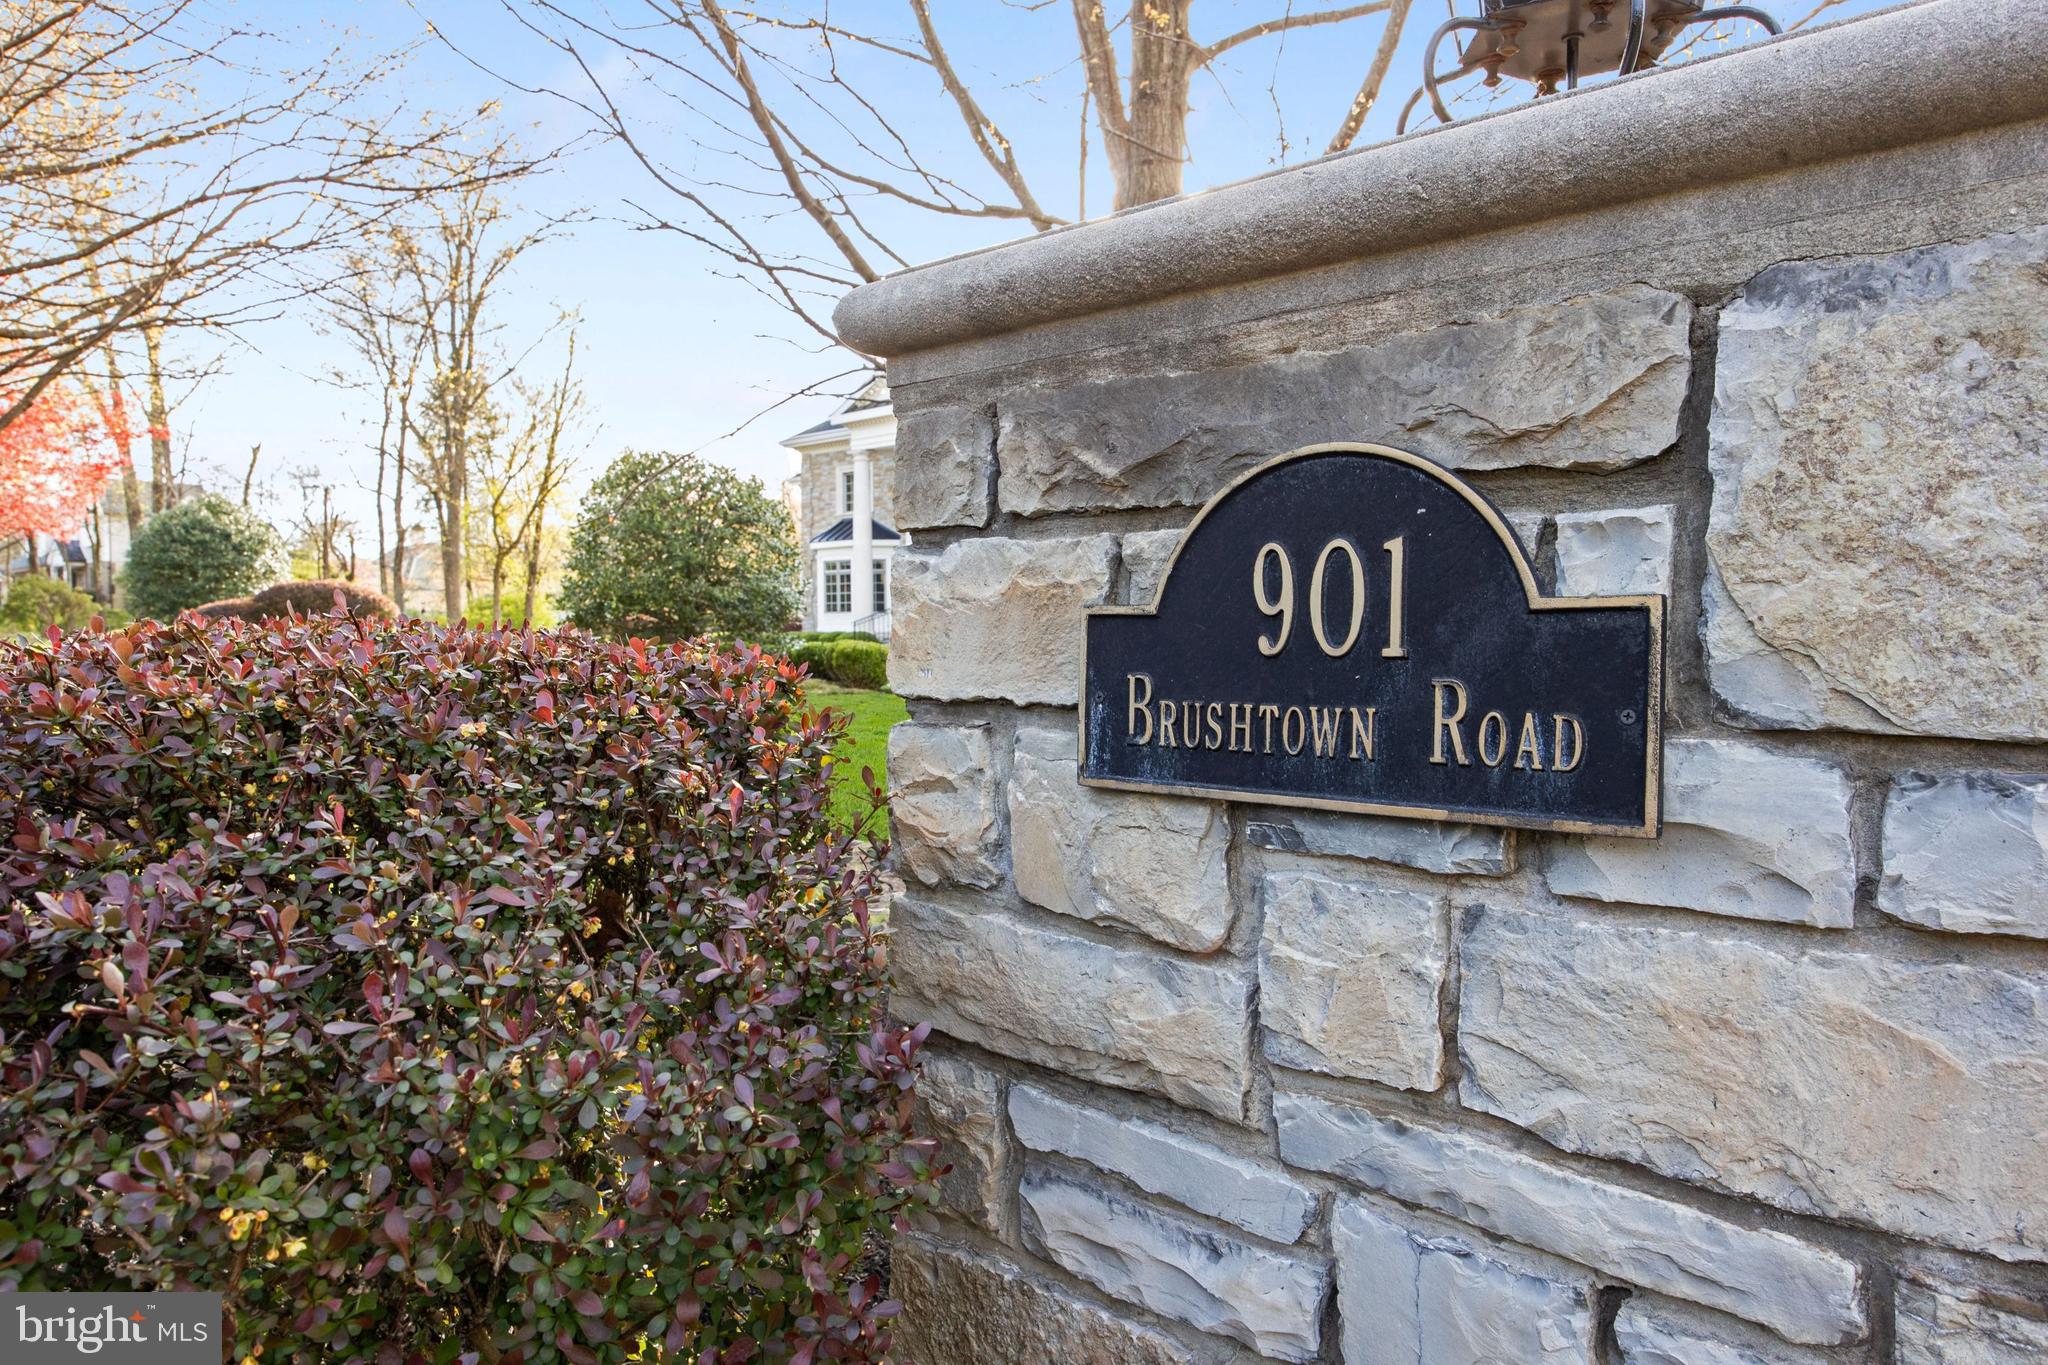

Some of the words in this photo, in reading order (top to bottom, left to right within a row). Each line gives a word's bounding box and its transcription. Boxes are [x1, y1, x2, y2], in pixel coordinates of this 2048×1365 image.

[1252, 535, 1408, 659] 901
[1126, 672, 1377, 761] BRUSHTOWN
[1429, 678, 1586, 773] ROAD
